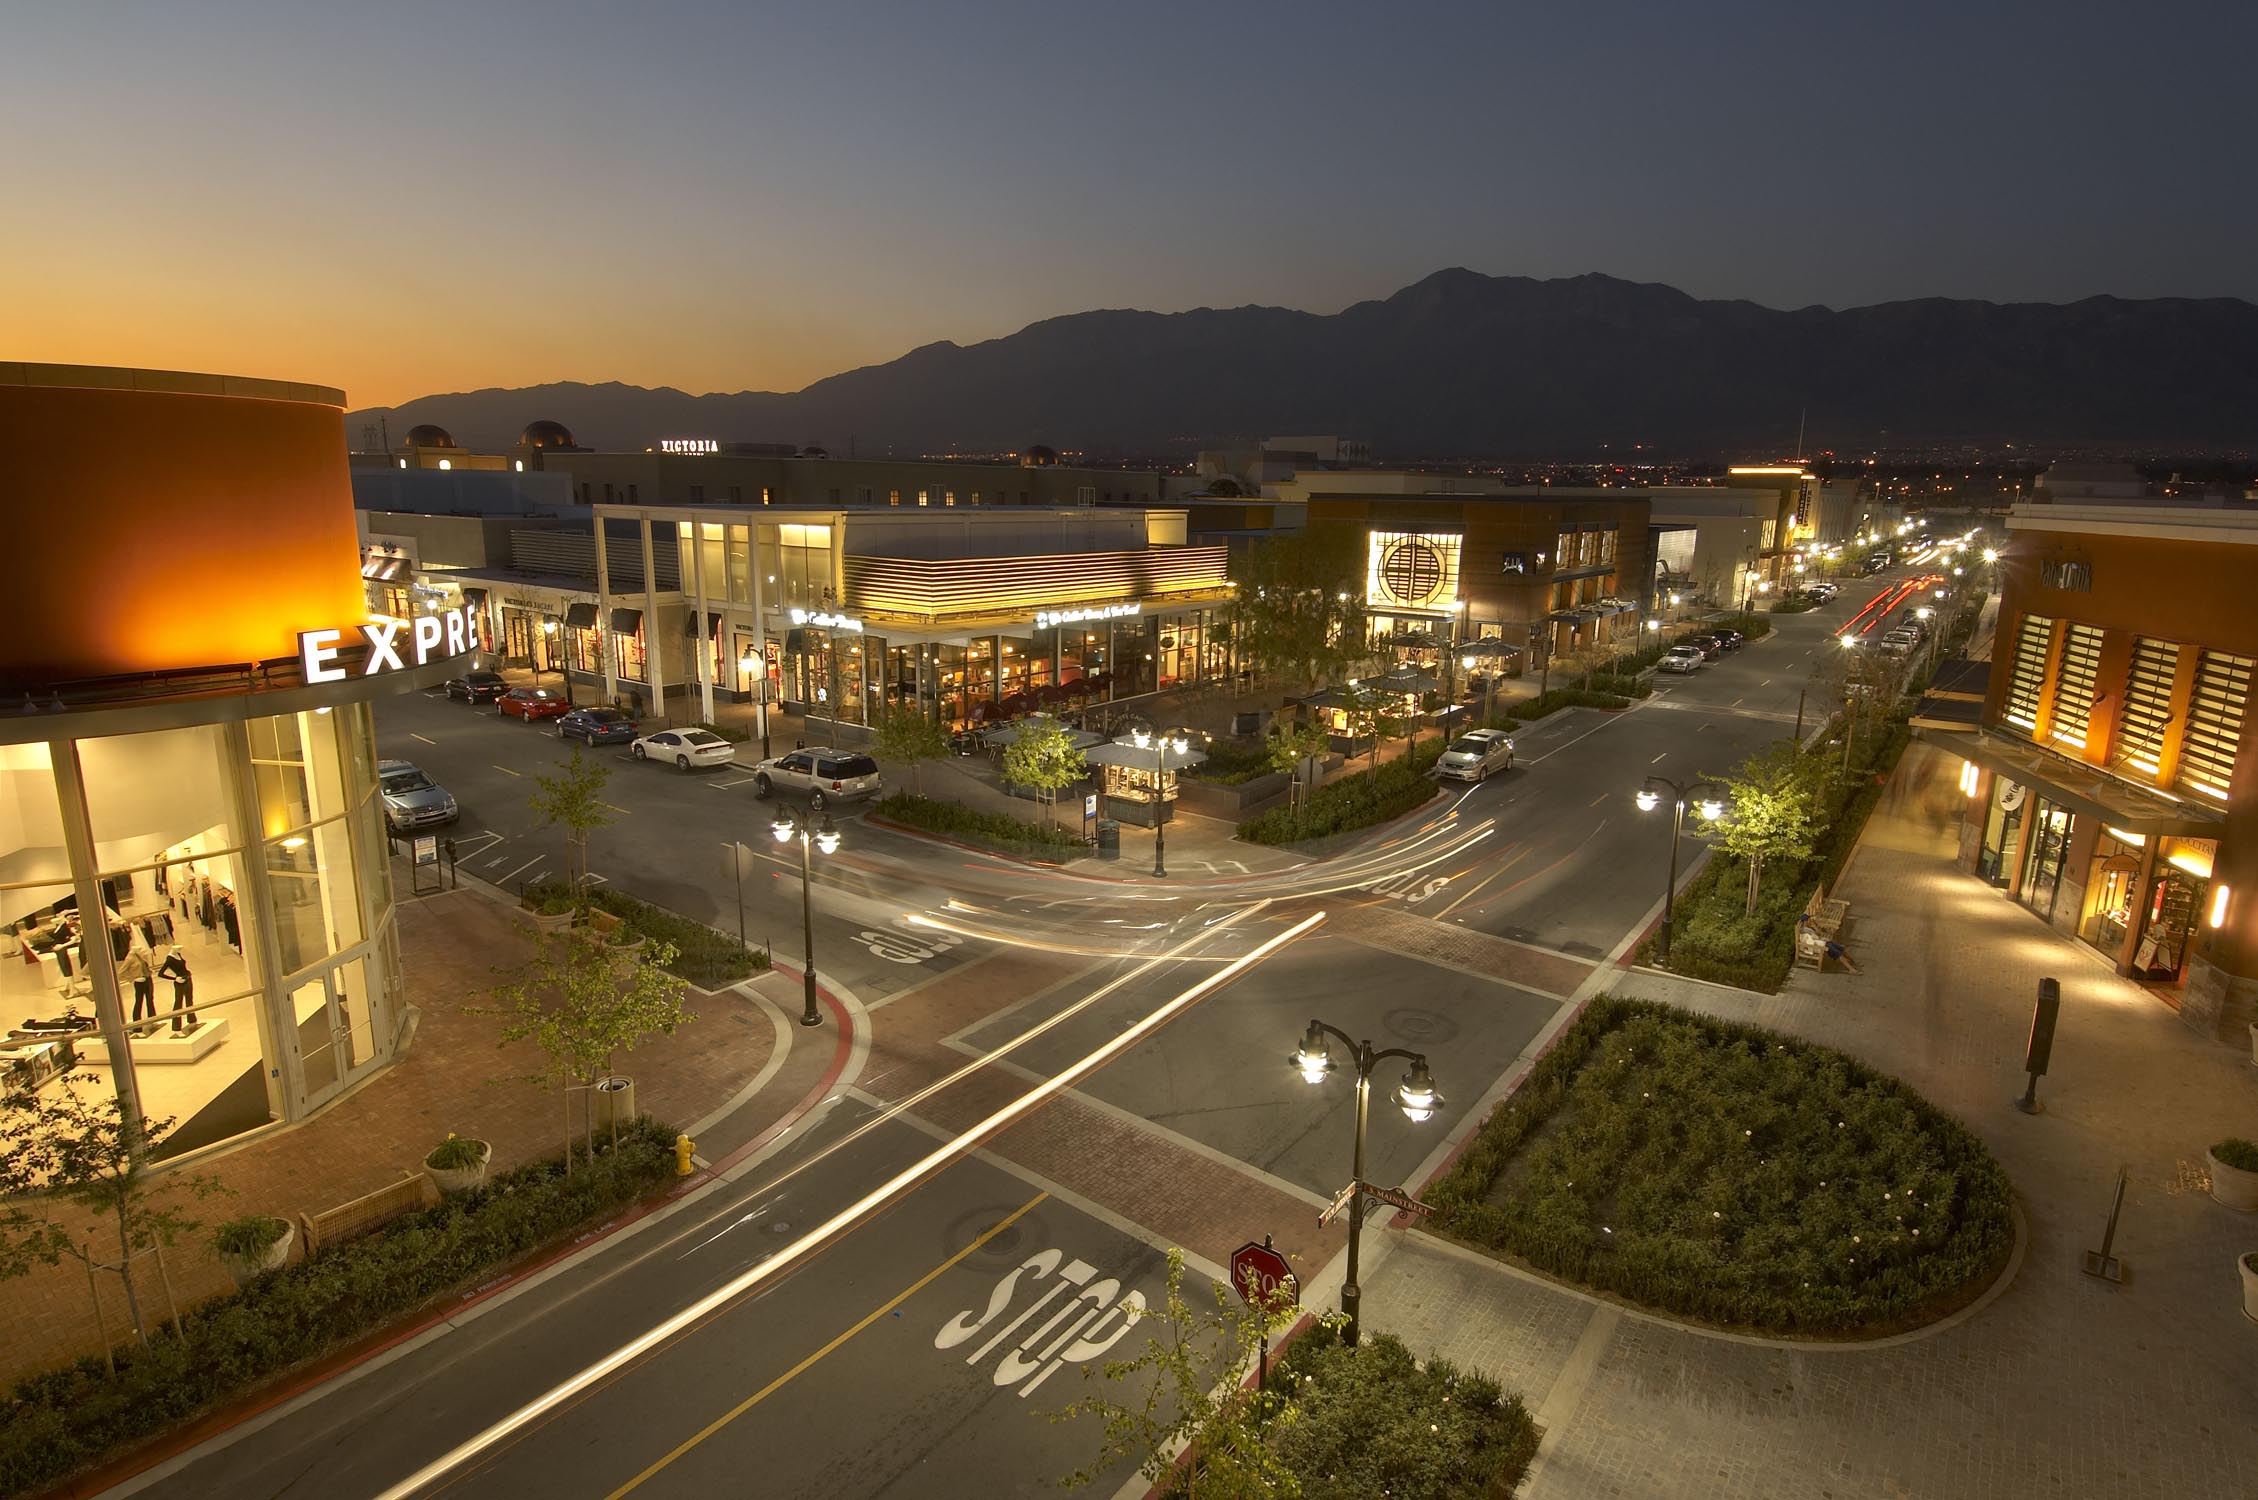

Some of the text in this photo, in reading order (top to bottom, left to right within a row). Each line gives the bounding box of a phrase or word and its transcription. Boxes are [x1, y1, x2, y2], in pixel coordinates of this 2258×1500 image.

[661, 440, 718, 452] VICTORIA
[300, 604, 478, 685] EXPRE
[934, 1248, 1147, 1398] STOP
